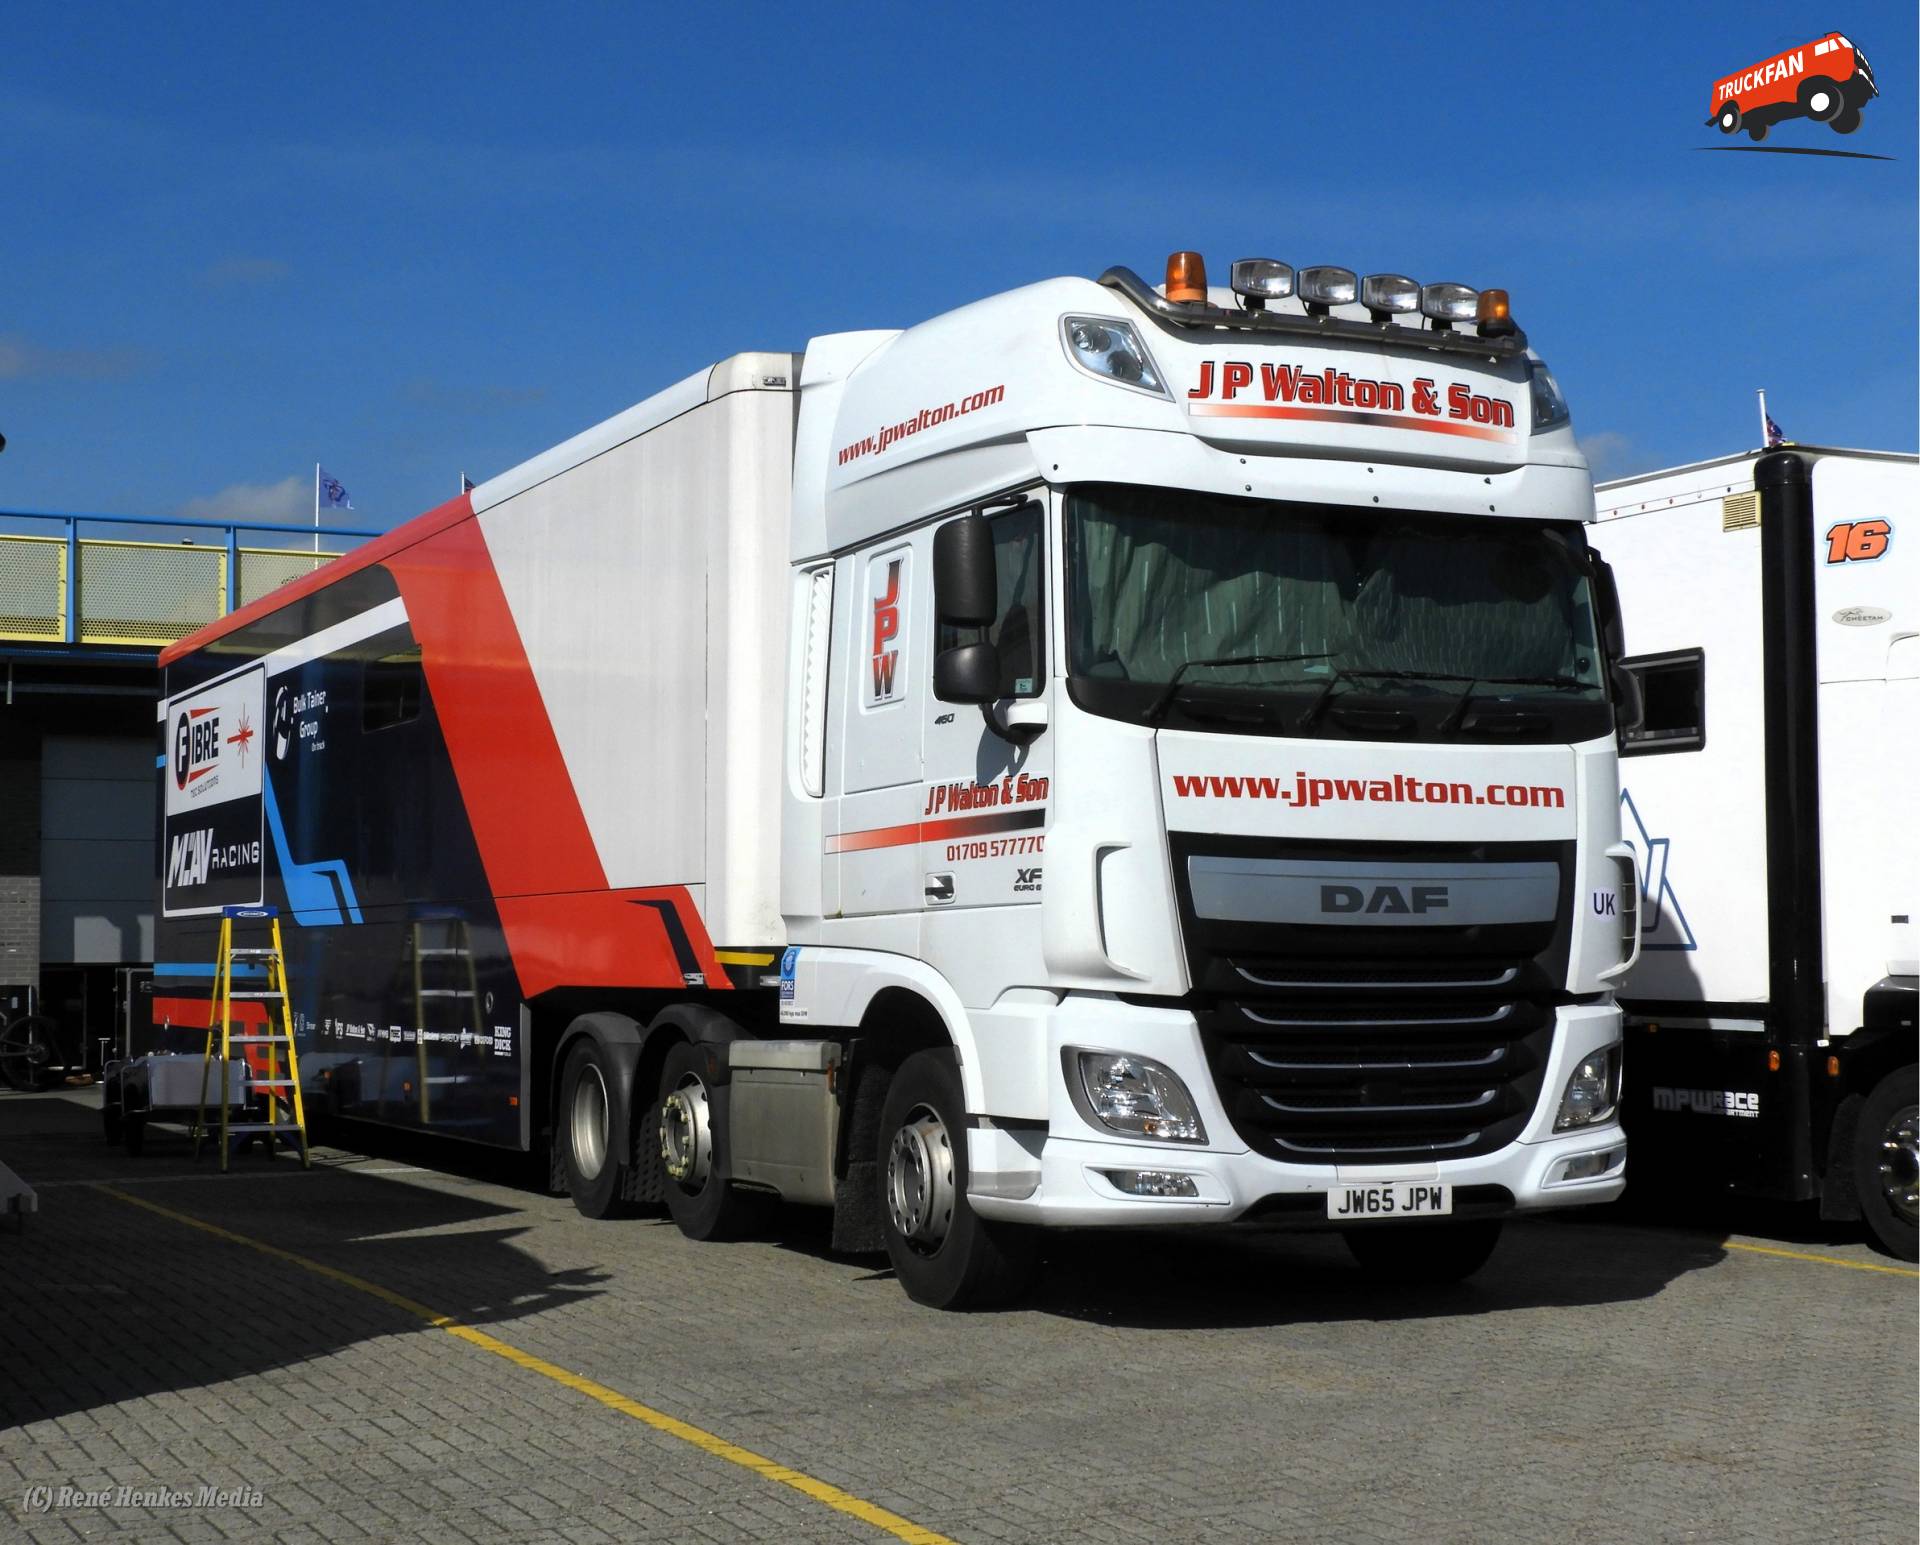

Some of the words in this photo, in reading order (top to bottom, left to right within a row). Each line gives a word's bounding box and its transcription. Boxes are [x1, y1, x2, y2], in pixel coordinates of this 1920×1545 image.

[1187, 360, 1215, 399] J
[1222, 361, 1254, 400] P
[1260, 363, 1404, 412] Walton
[1411, 377, 1442, 416] &
[1448, 382, 1515, 428] Son
[838, 384, 1005, 466] www.jpwalton.com
[1826, 519, 1892, 564] 16
[300, 721, 319, 739] Group
[934, 713, 955, 726] 460
[178, 716, 220, 774] FIBRE
[924, 786, 935, 816] J
[935, 785, 947, 814] P
[947, 780, 999, 812] Walton
[1001, 775, 1014, 805] &
[1016, 772, 1049, 804] Son
[1173, 771, 1565, 808] www.jpwalton.com
[212, 841, 260, 869] RACING
[946, 841, 988, 862] 01709
[1013, 884, 1035, 892] EURO
[1015, 868, 1043, 884] XF
[1320, 885, 1449, 914] DAF
[1593, 892, 1616, 916] UK
[494, 1025, 512, 1038] KING
[494, 1038, 512, 1051] DICK
[1338, 1188, 1395, 1214] JW65
[1401, 1186, 1442, 1211] JPW
